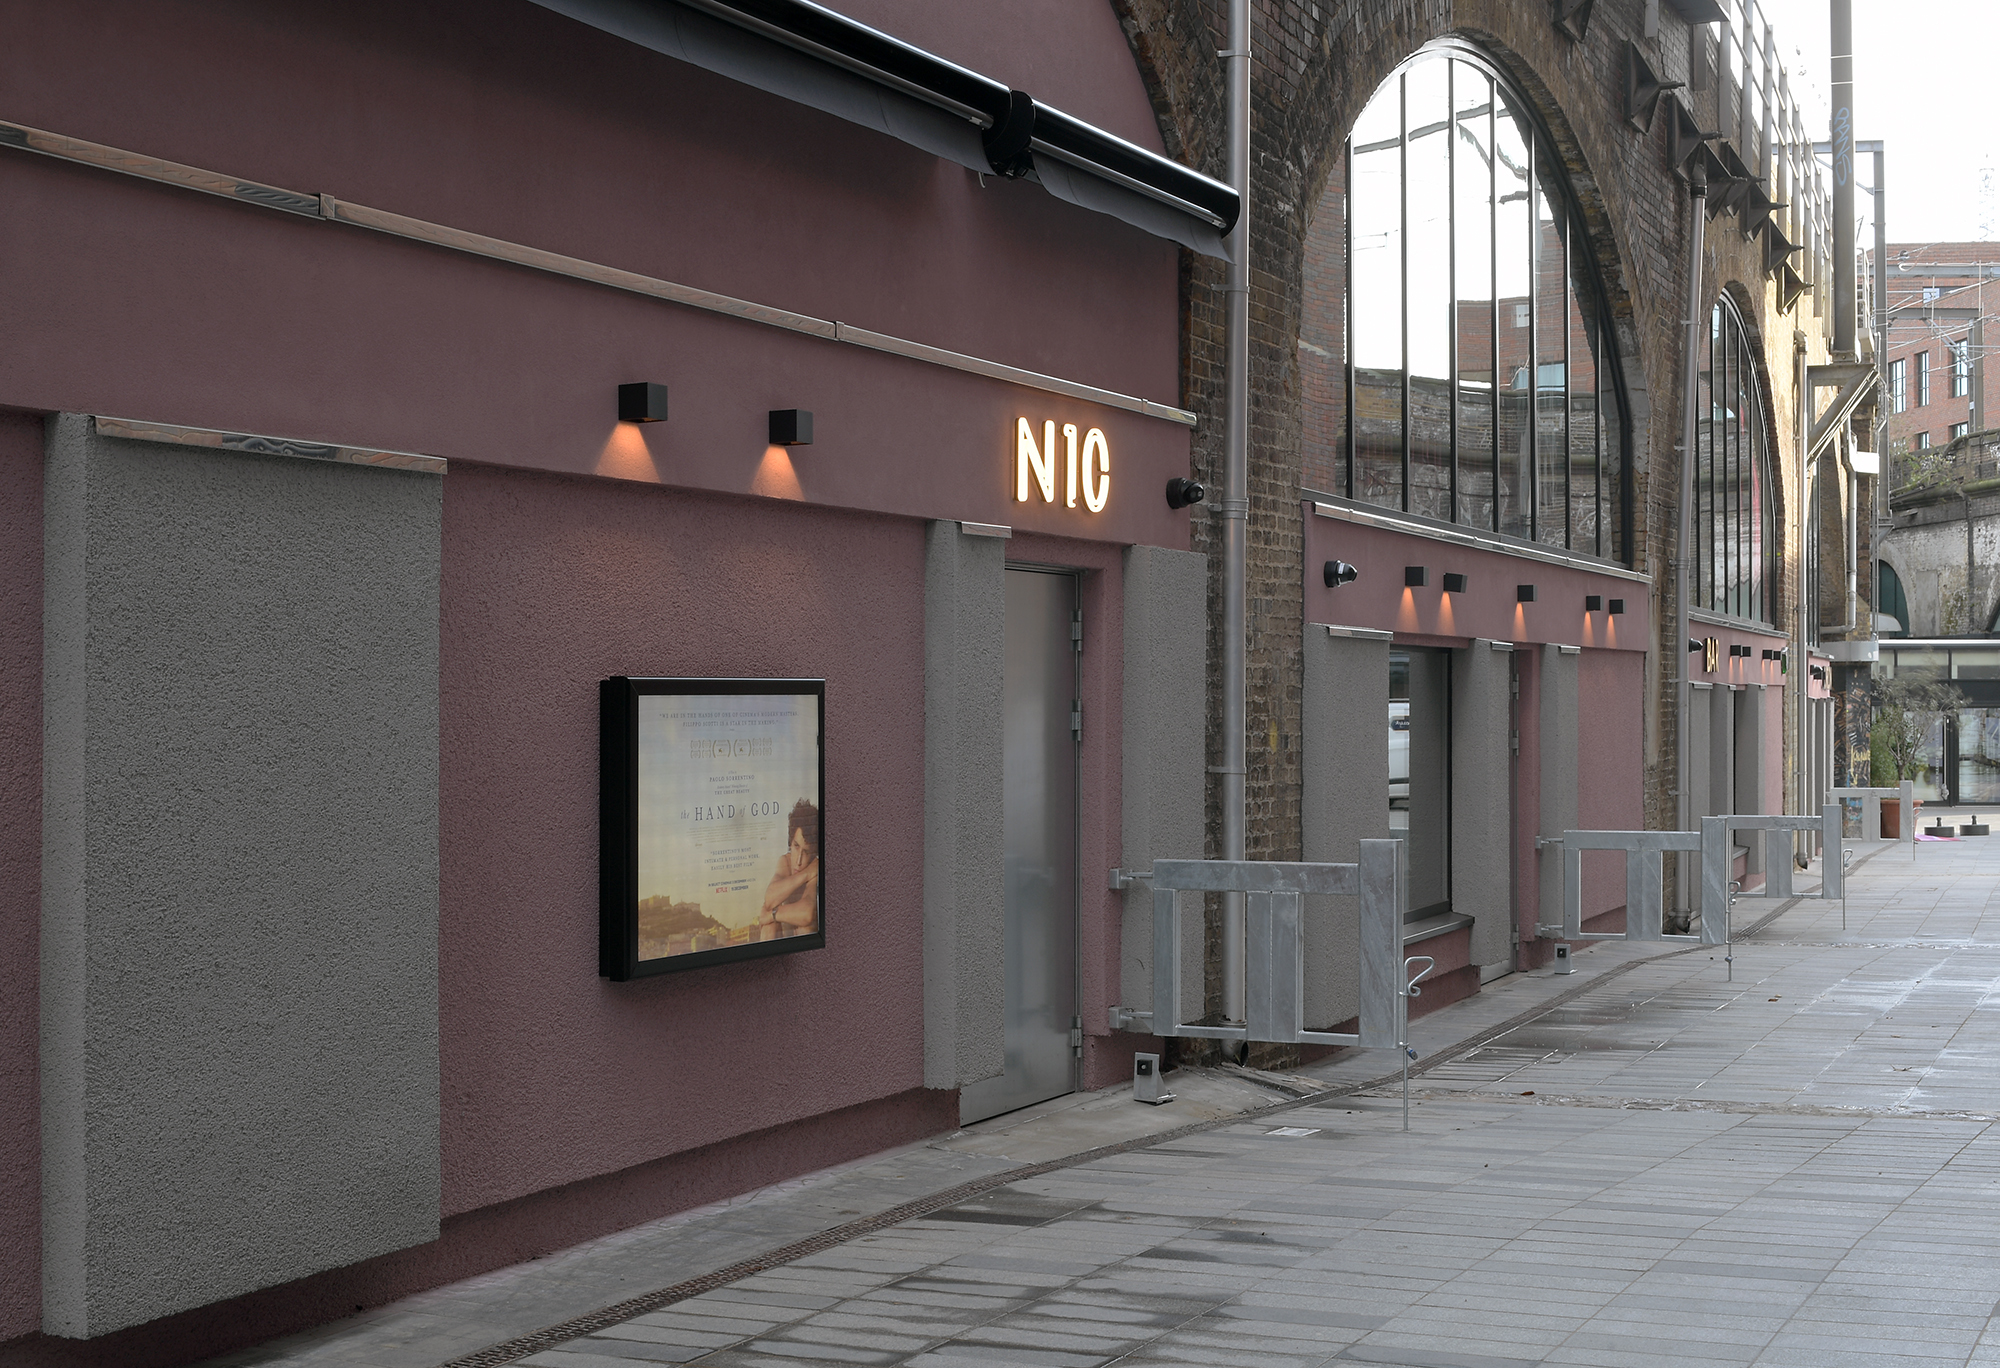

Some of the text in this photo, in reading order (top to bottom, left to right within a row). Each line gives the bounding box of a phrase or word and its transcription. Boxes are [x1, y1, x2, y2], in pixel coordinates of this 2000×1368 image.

[1705, 636, 1719, 673] BAR
[726, 774, 755, 782] SORRENTINO
[680, 801, 780, 821] the HAND of GOD
[715, 886, 728, 894] NETFLIX
